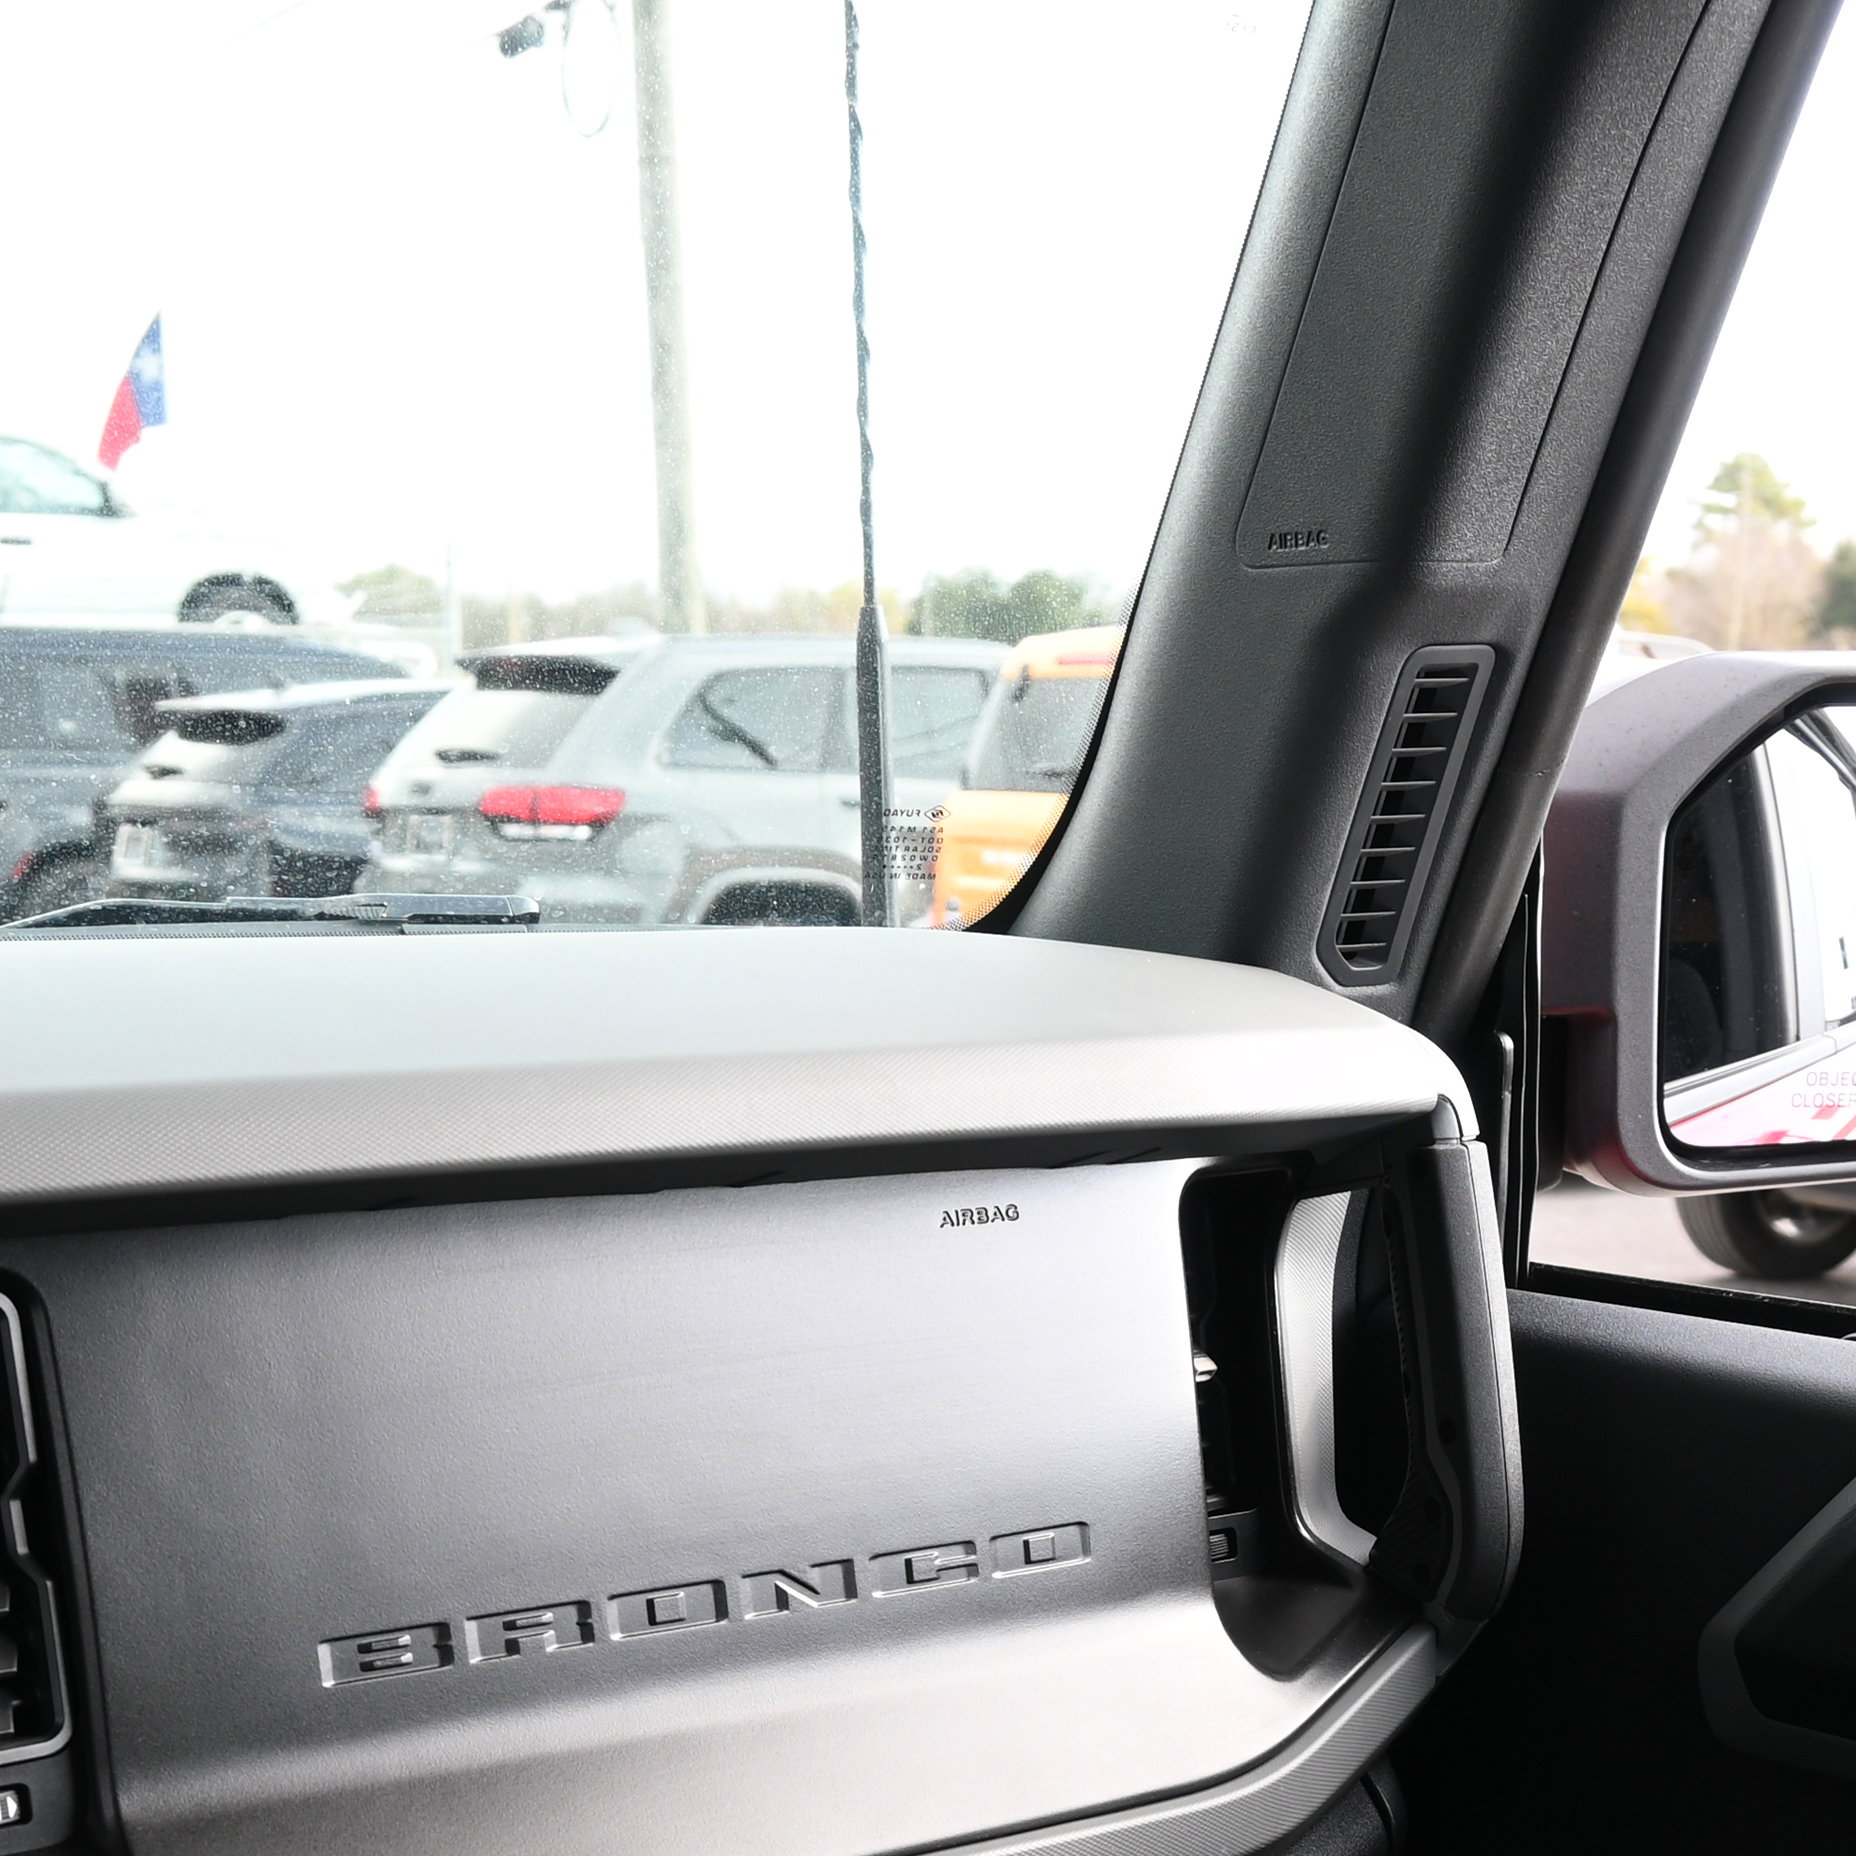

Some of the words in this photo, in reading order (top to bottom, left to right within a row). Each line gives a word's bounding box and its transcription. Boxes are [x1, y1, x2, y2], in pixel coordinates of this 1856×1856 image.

[1267, 529, 1331, 552] AIRBAG
[939, 1203, 1020, 1229] AIRBAG
[317, 1520, 1092, 1689] BRONCO
